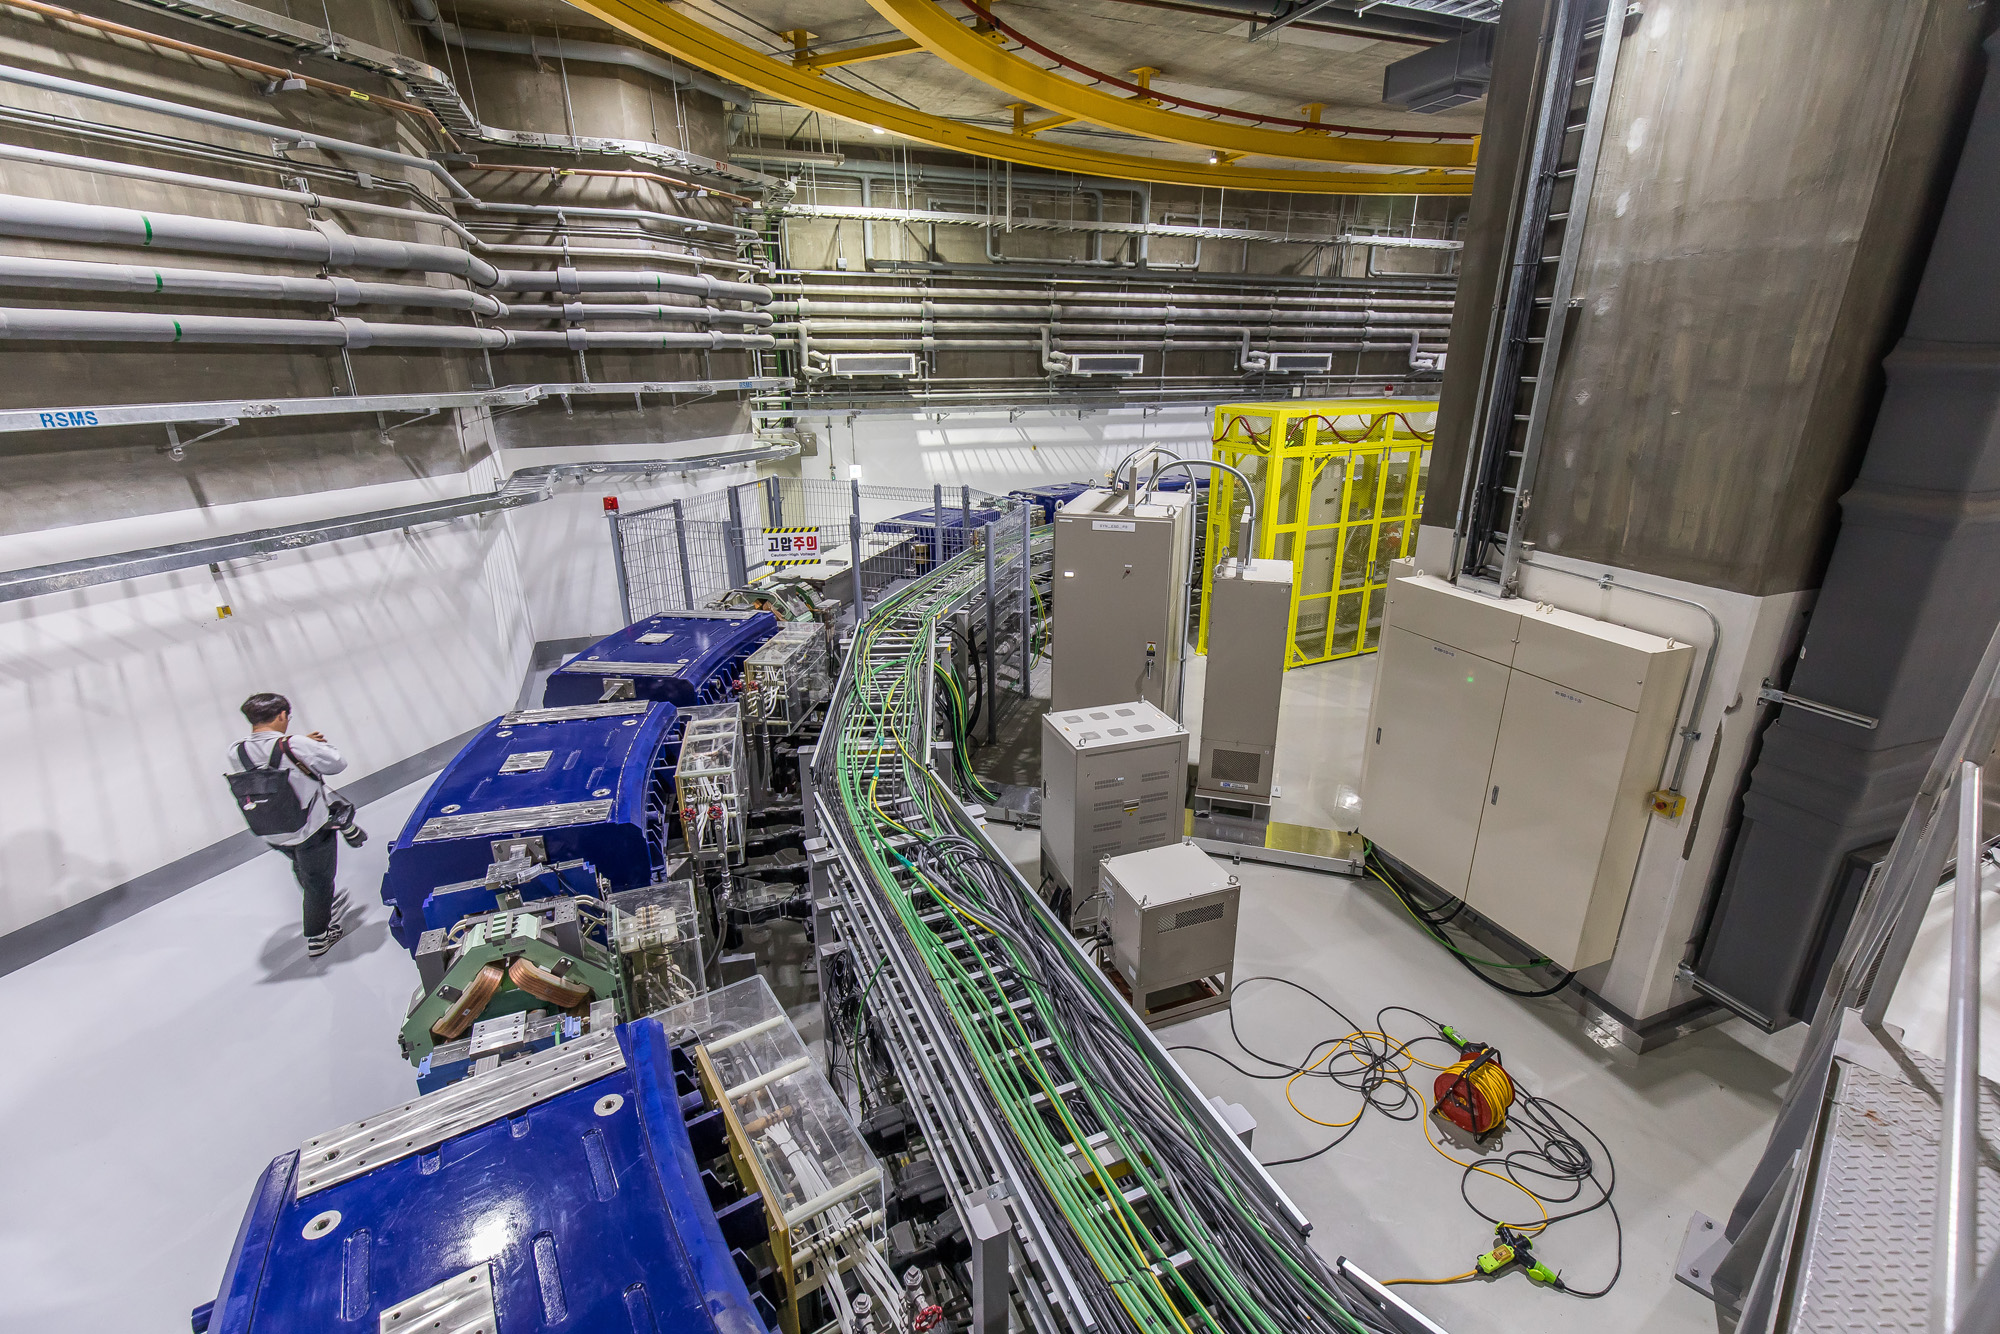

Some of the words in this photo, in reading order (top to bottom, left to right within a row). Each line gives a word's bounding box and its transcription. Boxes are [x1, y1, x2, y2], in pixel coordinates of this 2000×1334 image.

[715, 161, 728, 172] 전기
[40, 411, 99, 428] RSMS
[768, 536, 817, 552] 고압주의
